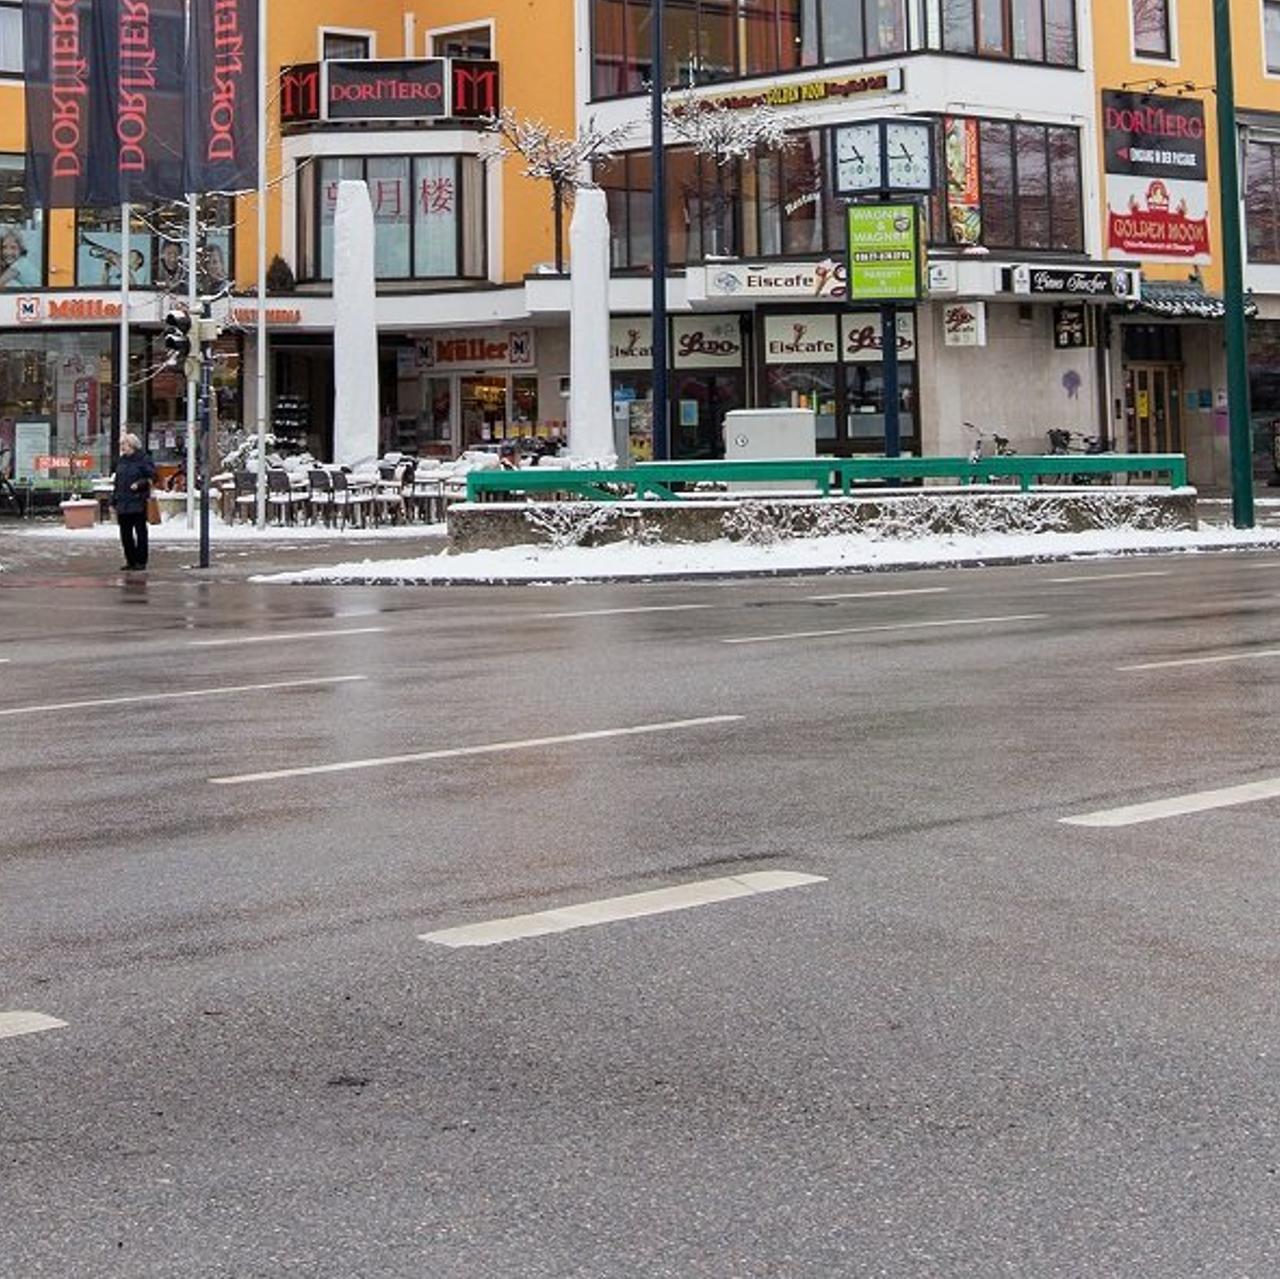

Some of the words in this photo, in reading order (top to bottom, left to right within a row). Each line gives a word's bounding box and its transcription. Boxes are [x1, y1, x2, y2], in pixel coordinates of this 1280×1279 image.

[330, 79, 442, 102] DORMERO
[1106, 106, 1203, 139] DORMERO
[1113, 218, 1165, 240] GOLDEN
[1168, 223, 1204, 243] MOON
[747, 273, 814, 288] Eiscafe
[436, 338, 508, 361] Müller
[769, 340, 834, 354] Eiscafe
